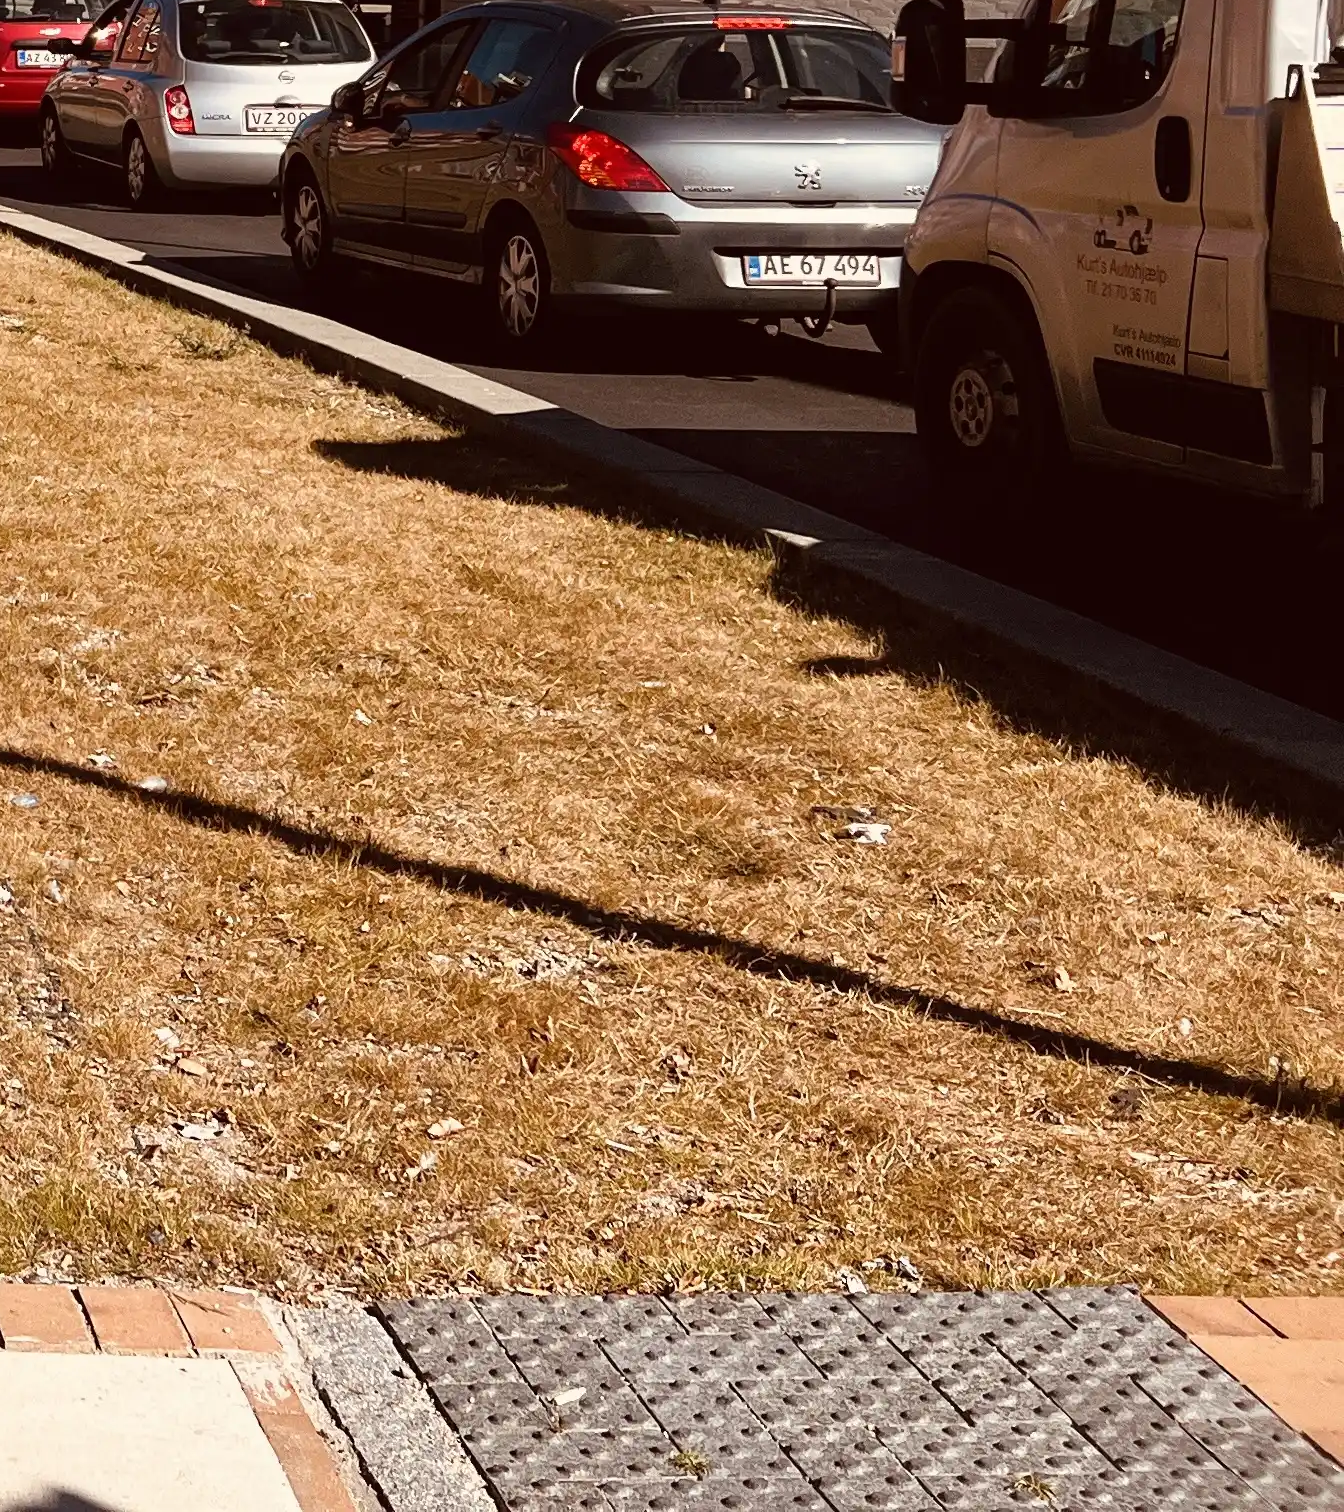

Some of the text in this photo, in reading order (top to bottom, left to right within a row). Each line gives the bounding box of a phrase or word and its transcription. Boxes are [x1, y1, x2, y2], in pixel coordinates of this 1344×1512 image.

[252, 113, 273, 125] VZ
[764, 255, 876, 276] AE 67 494
[1114, 343, 1134, 358] CVR
